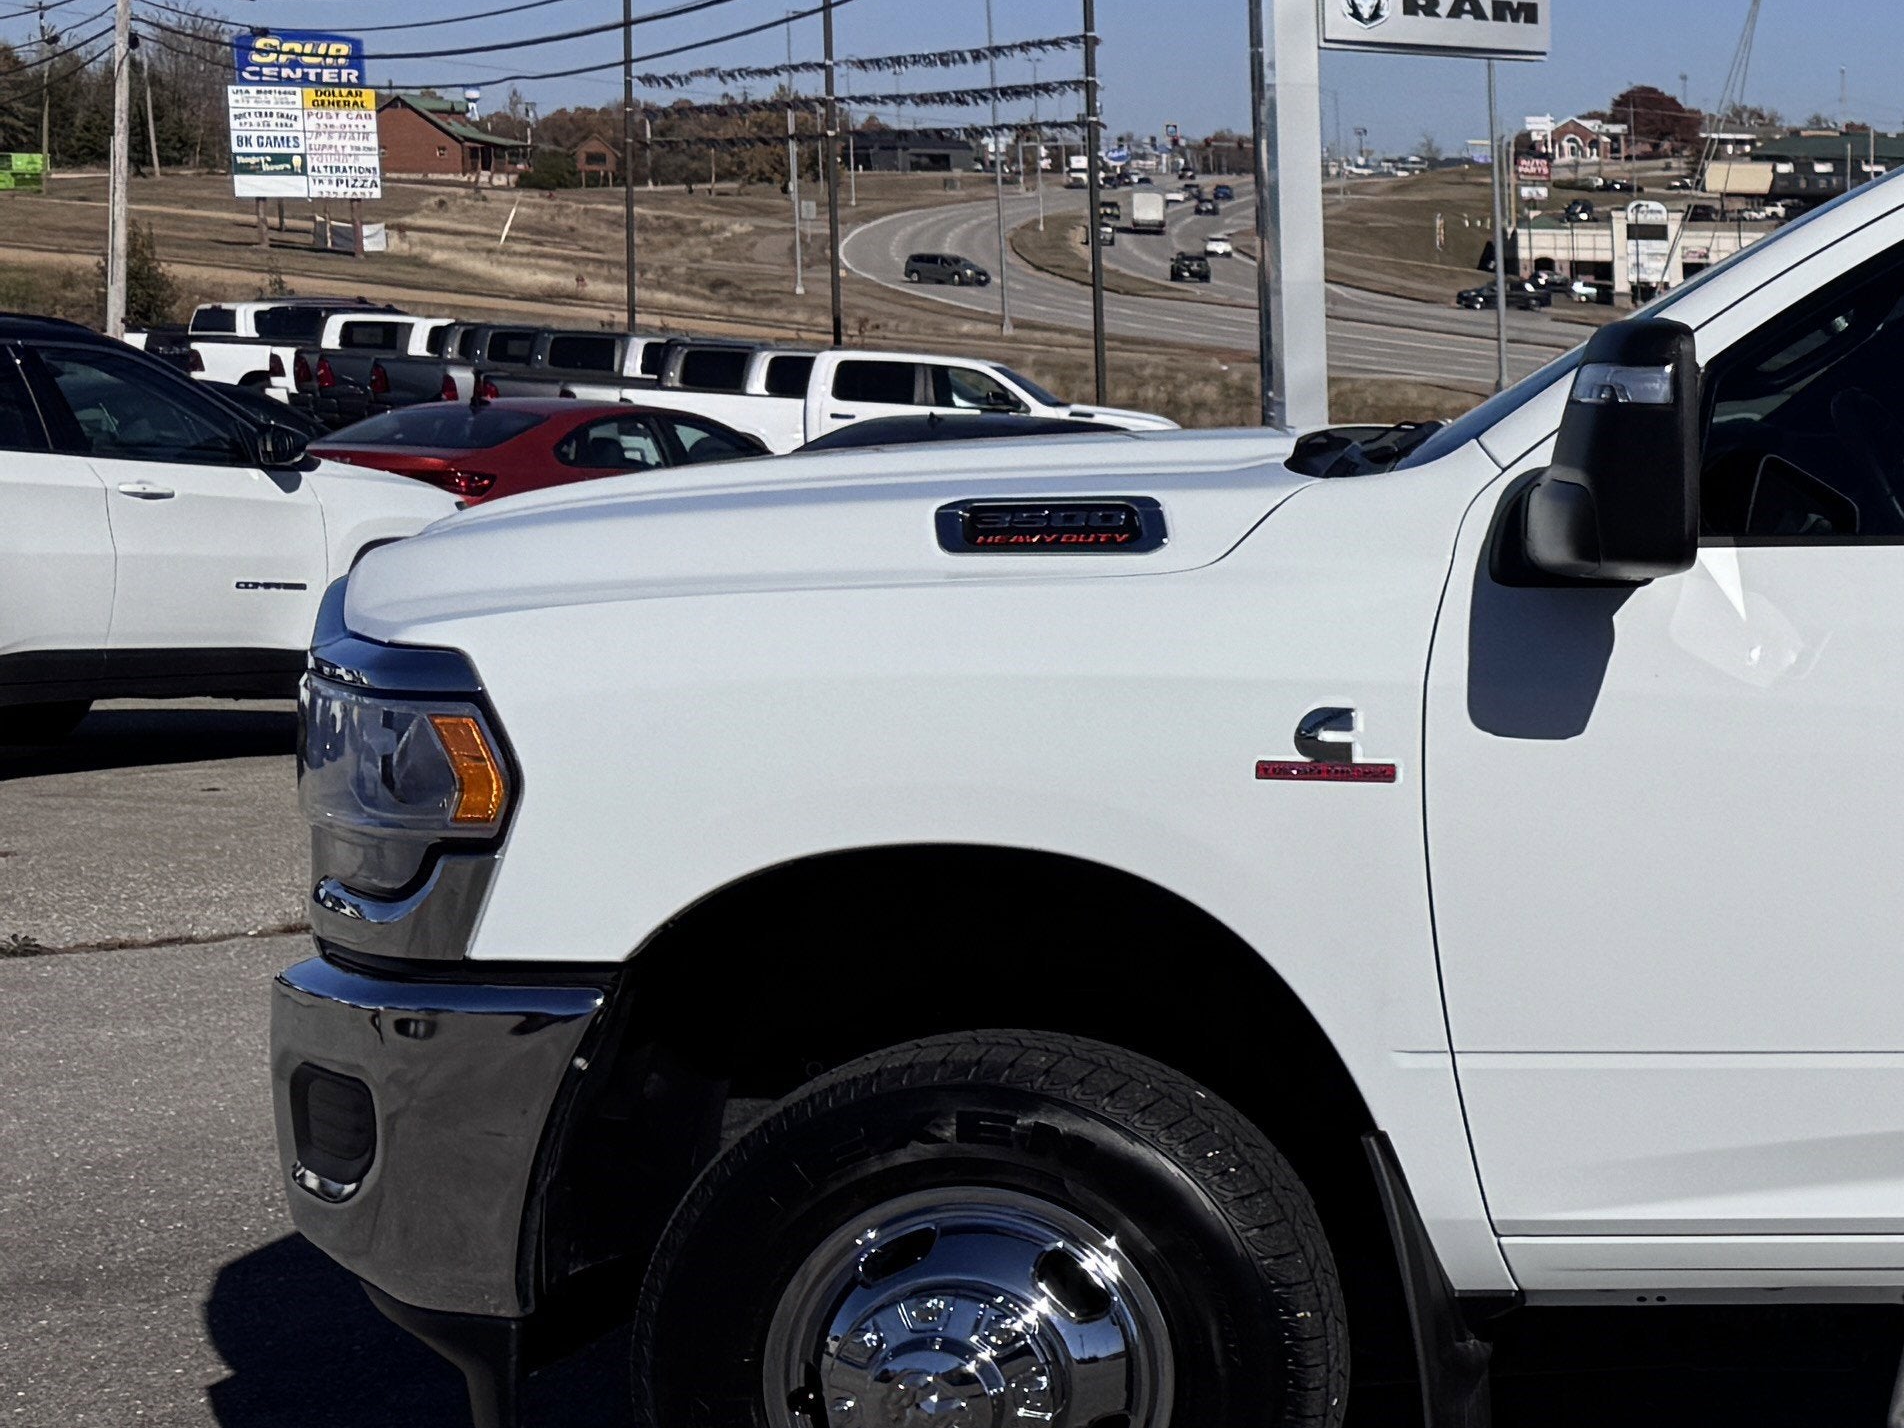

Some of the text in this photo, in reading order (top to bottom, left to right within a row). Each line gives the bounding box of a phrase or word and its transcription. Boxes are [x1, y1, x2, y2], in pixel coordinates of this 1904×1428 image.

[242, 66, 359, 84] CENTER
[315, 89, 362, 98] DOLLAR
[312, 99, 367, 108] GENERAL
[256, 135, 300, 148] GAMES
[311, 165, 378, 174] ALTERATIONS
[336, 178, 378, 188] PIZZA
[974, 511, 1127, 528] 3500
[975, 533, 1130, 545] HEAVY DUTY
